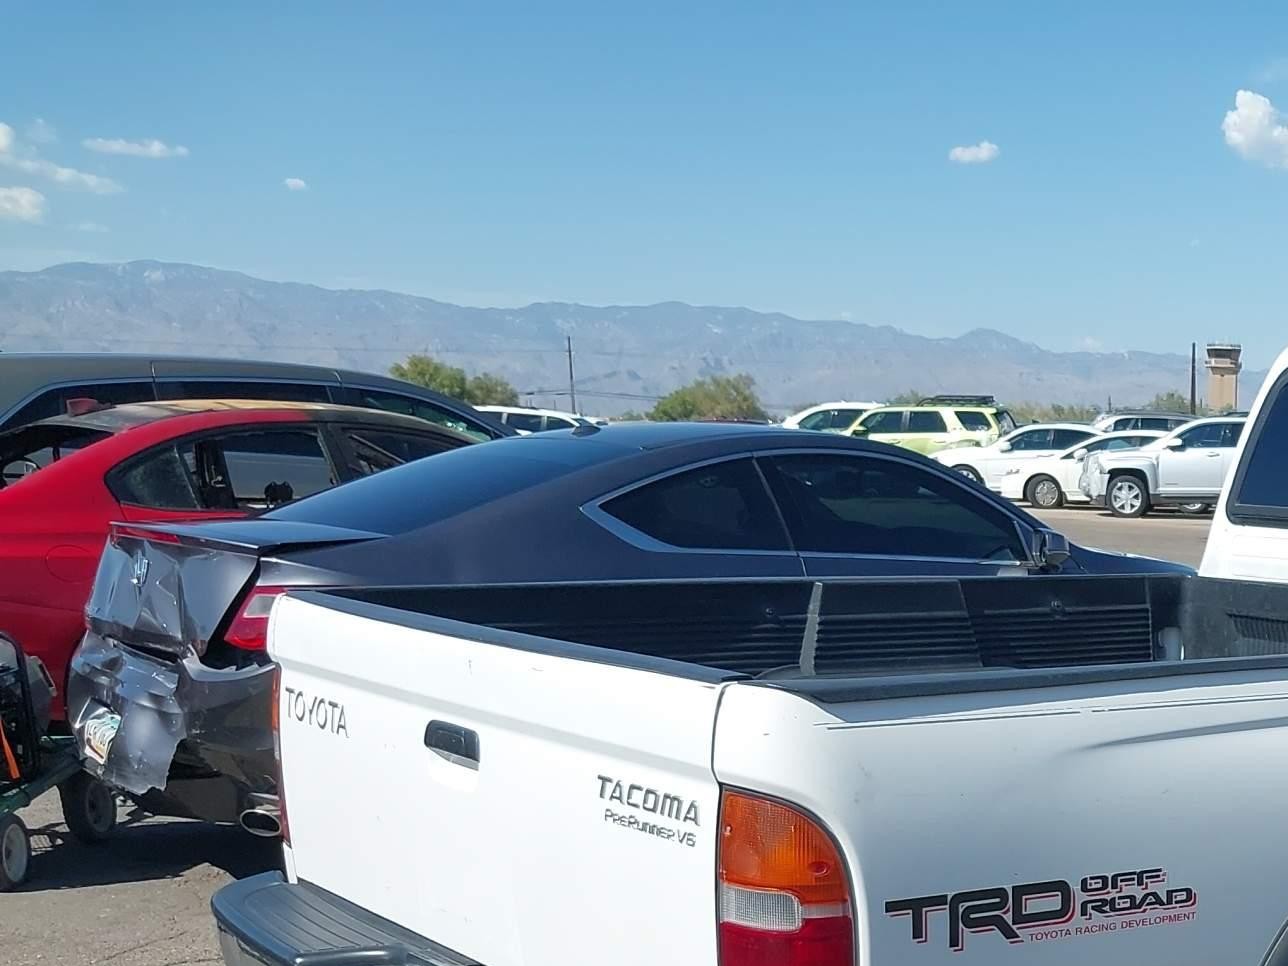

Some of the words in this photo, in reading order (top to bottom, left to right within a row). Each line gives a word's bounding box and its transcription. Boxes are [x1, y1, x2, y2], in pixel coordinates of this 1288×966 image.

[285, 686, 350, 738] TOYOTA
[597, 774, 701, 827] TACOMA
[677, 829, 697, 848] V6
[1080, 867, 1166, 896] OFF
[884, 879, 1076, 952] TRD
[1080, 887, 1197, 921] ROAD
[1029, 928, 1072, 942] TOYOTA
[1075, 921, 1117, 937] RACING
[1121, 911, 1197, 930] DEVELOPMENT
